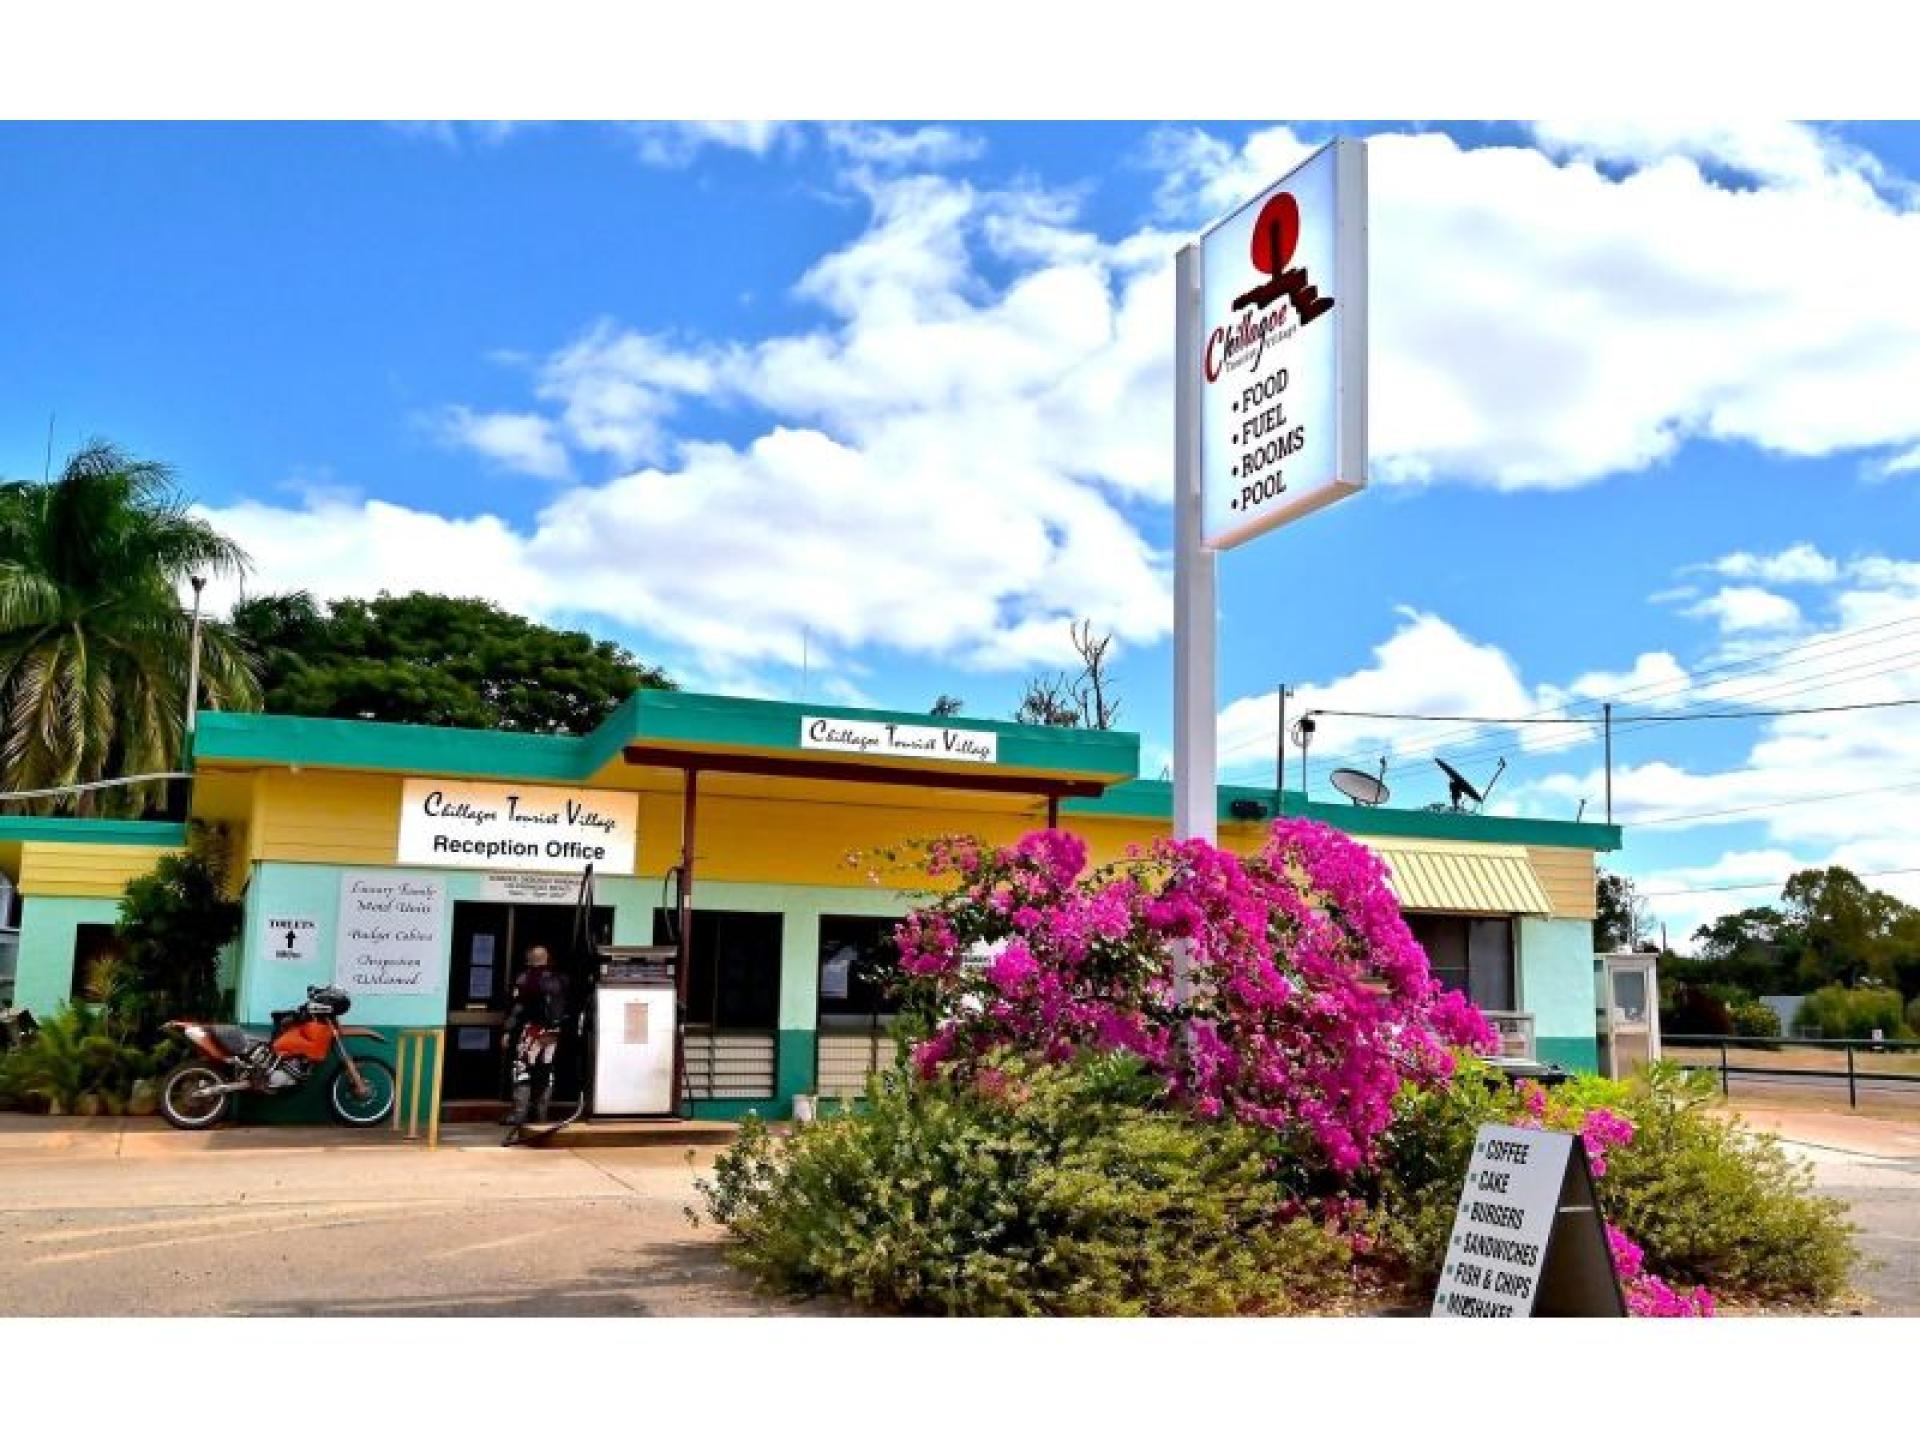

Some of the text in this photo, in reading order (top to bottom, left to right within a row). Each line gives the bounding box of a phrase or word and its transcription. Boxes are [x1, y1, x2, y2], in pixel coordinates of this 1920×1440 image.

[1205, 303, 1288, 383] Chillagoe
[1242, 368, 1290, 413] FOOD
[1242, 403, 1287, 445] FUEL
[1241, 425, 1305, 478] ROOMS
[1240, 470, 1287, 511] POOL
[809, 719, 880, 750] Chillagoe
[884, 723, 937, 750] Tourist
[423, 791, 498, 826] Chillagoe
[506, 795, 560, 825] Tourist
[433, 835, 606, 860] Reception Office
[1485, 1139, 1530, 1165] COFFEE
[1479, 1170, 1510, 1193] CAKE
[1470, 1201, 1525, 1229] BURGERS
[1463, 1231, 1539, 1267] SANDWICHES
[1456, 1262, 1532, 1299] FISH & CHIPS
